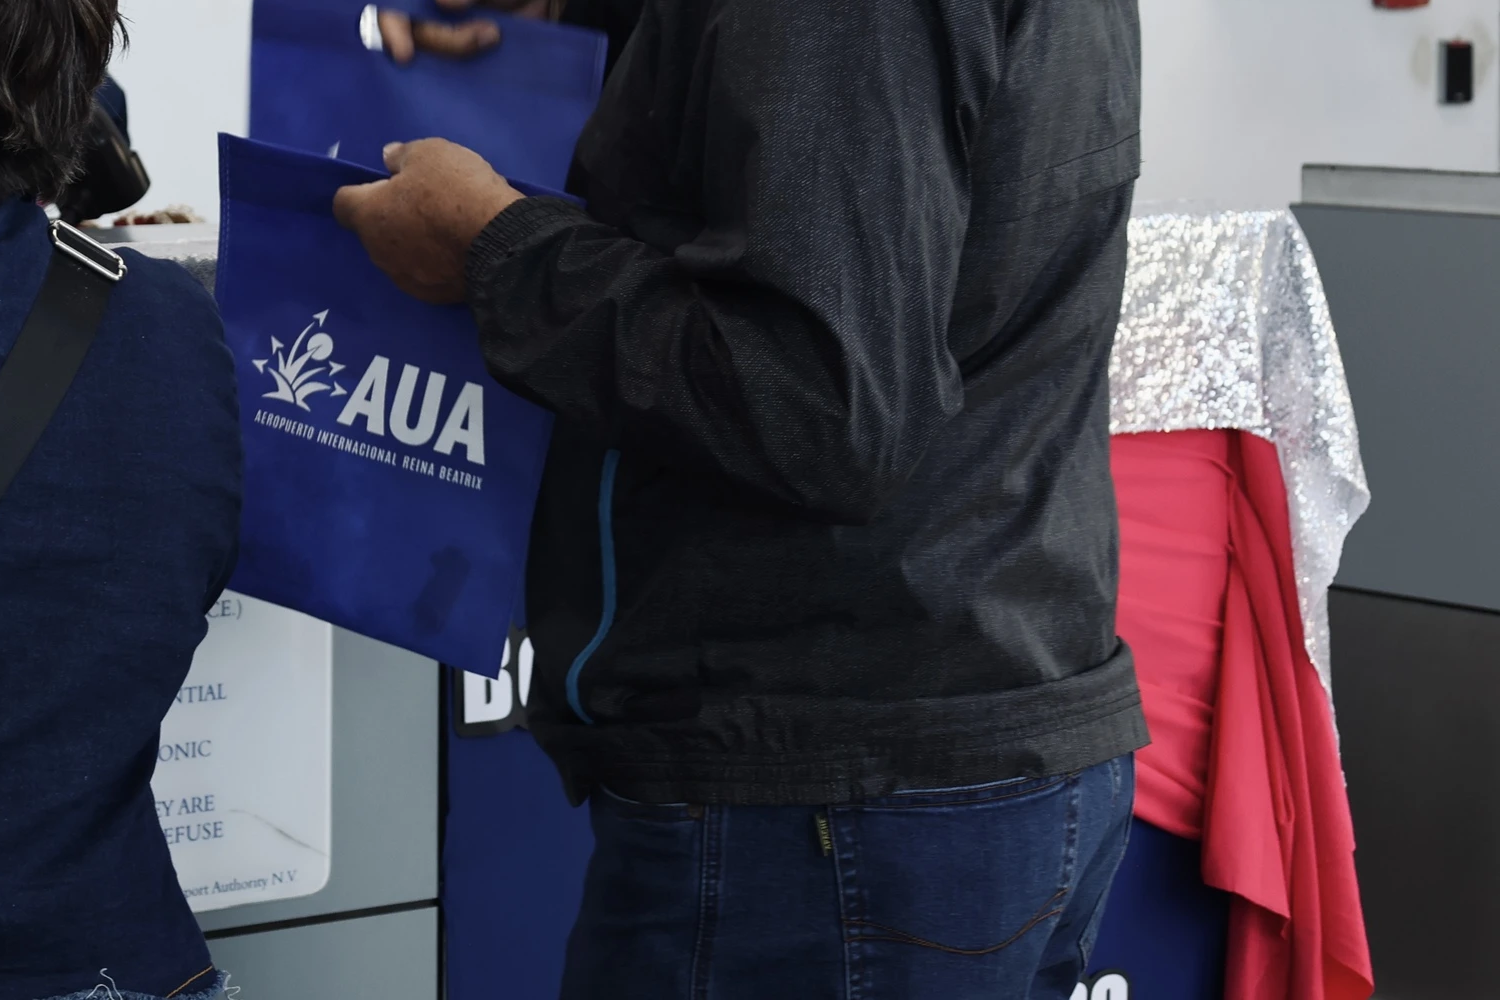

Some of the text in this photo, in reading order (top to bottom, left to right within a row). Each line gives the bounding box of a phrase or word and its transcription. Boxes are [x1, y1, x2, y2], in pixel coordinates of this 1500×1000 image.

[336, 354, 486, 465] AUA
[254, 409, 483, 491] AEROPUERTO INTERNACIONAL REINA BEATRIX
[206, 599, 243, 620] CE.)
[175, 683, 227, 704] NTIAL
[158, 740, 212, 762] ONIC
[155, 794, 215, 818] EY ARE
[163, 821, 224, 845] EFUSE
[183, 886, 208, 899] port
[212, 877, 267, 893] Authority
